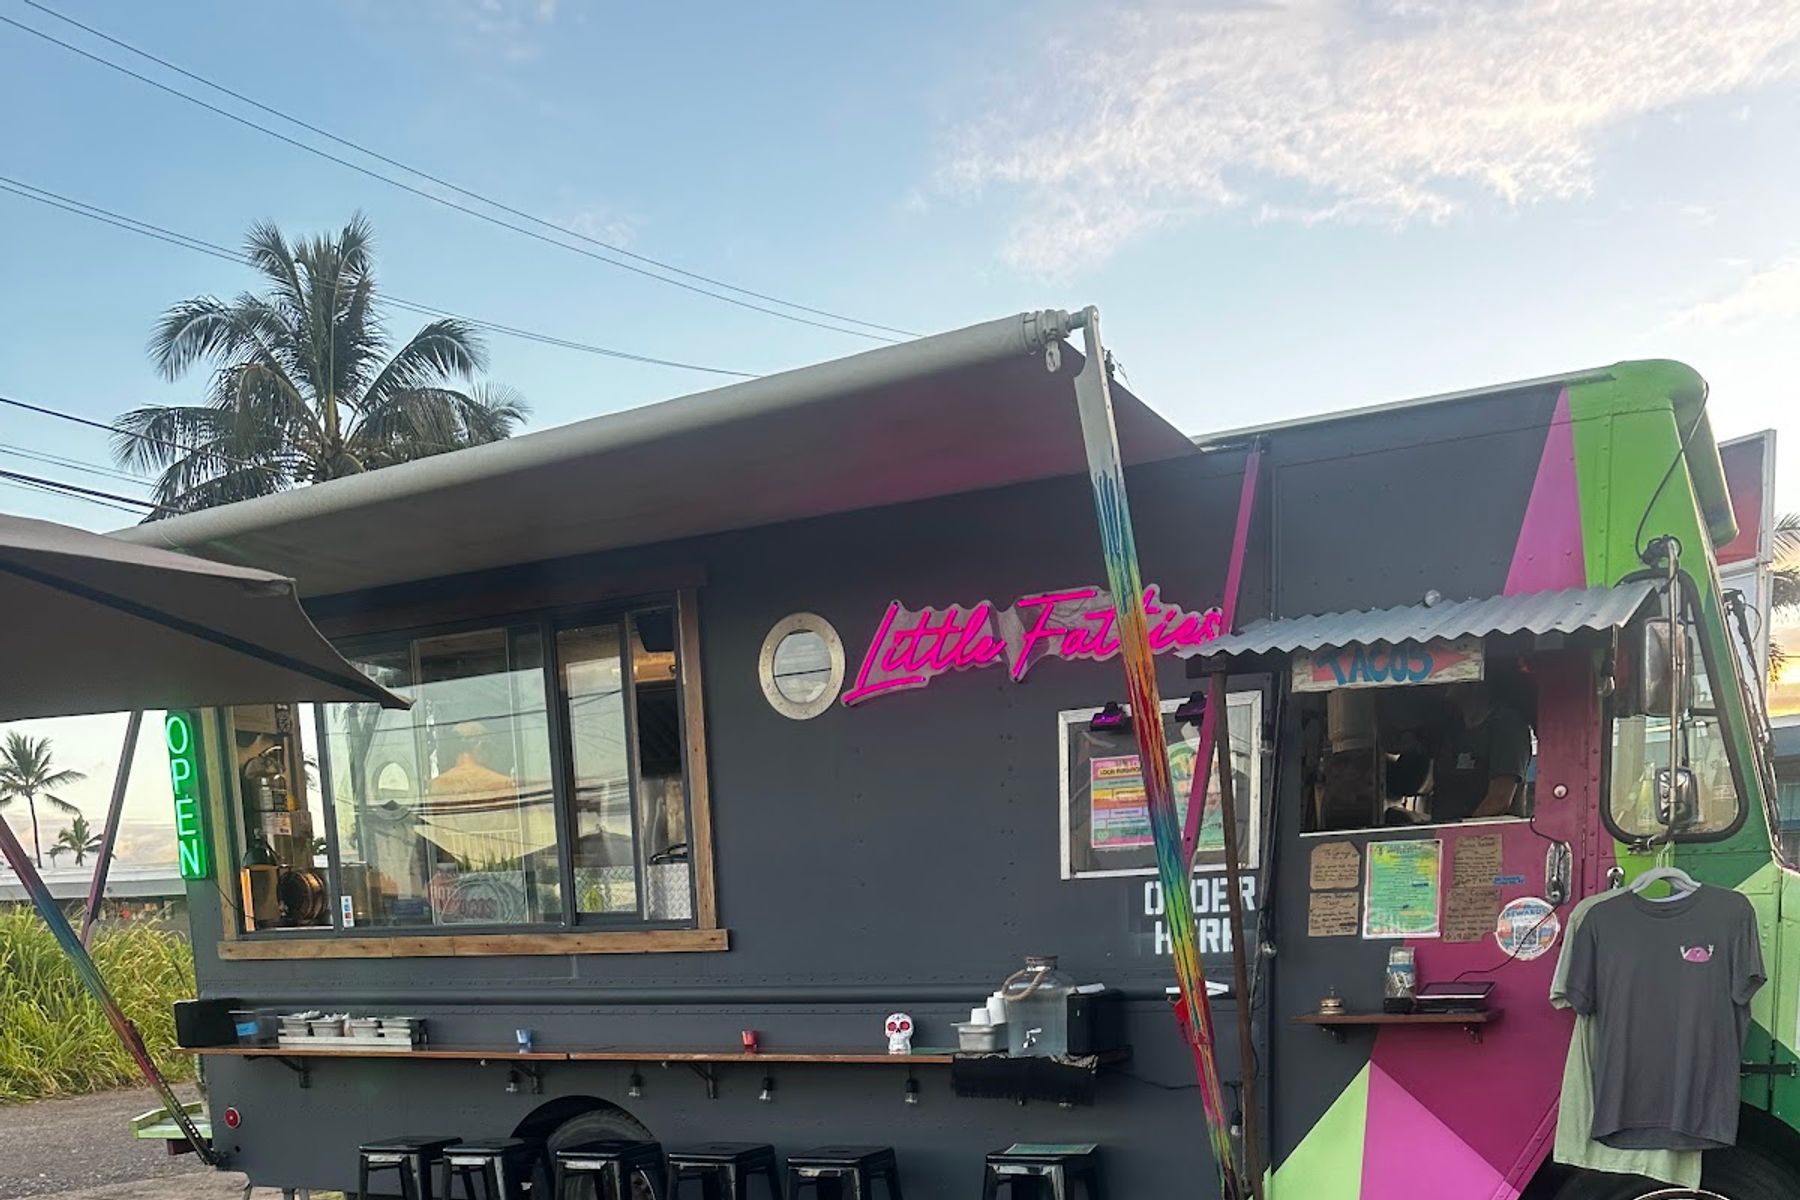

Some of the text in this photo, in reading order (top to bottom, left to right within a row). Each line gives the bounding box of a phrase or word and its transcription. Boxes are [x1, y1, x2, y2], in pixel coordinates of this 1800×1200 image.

[842, 600, 1006, 704] Little
[1316, 643, 1434, 686] TACOS
[165, 715, 201, 876] OPEN
[1145, 876, 1256, 915] ODER
[1155, 917, 1234, 955] HR
